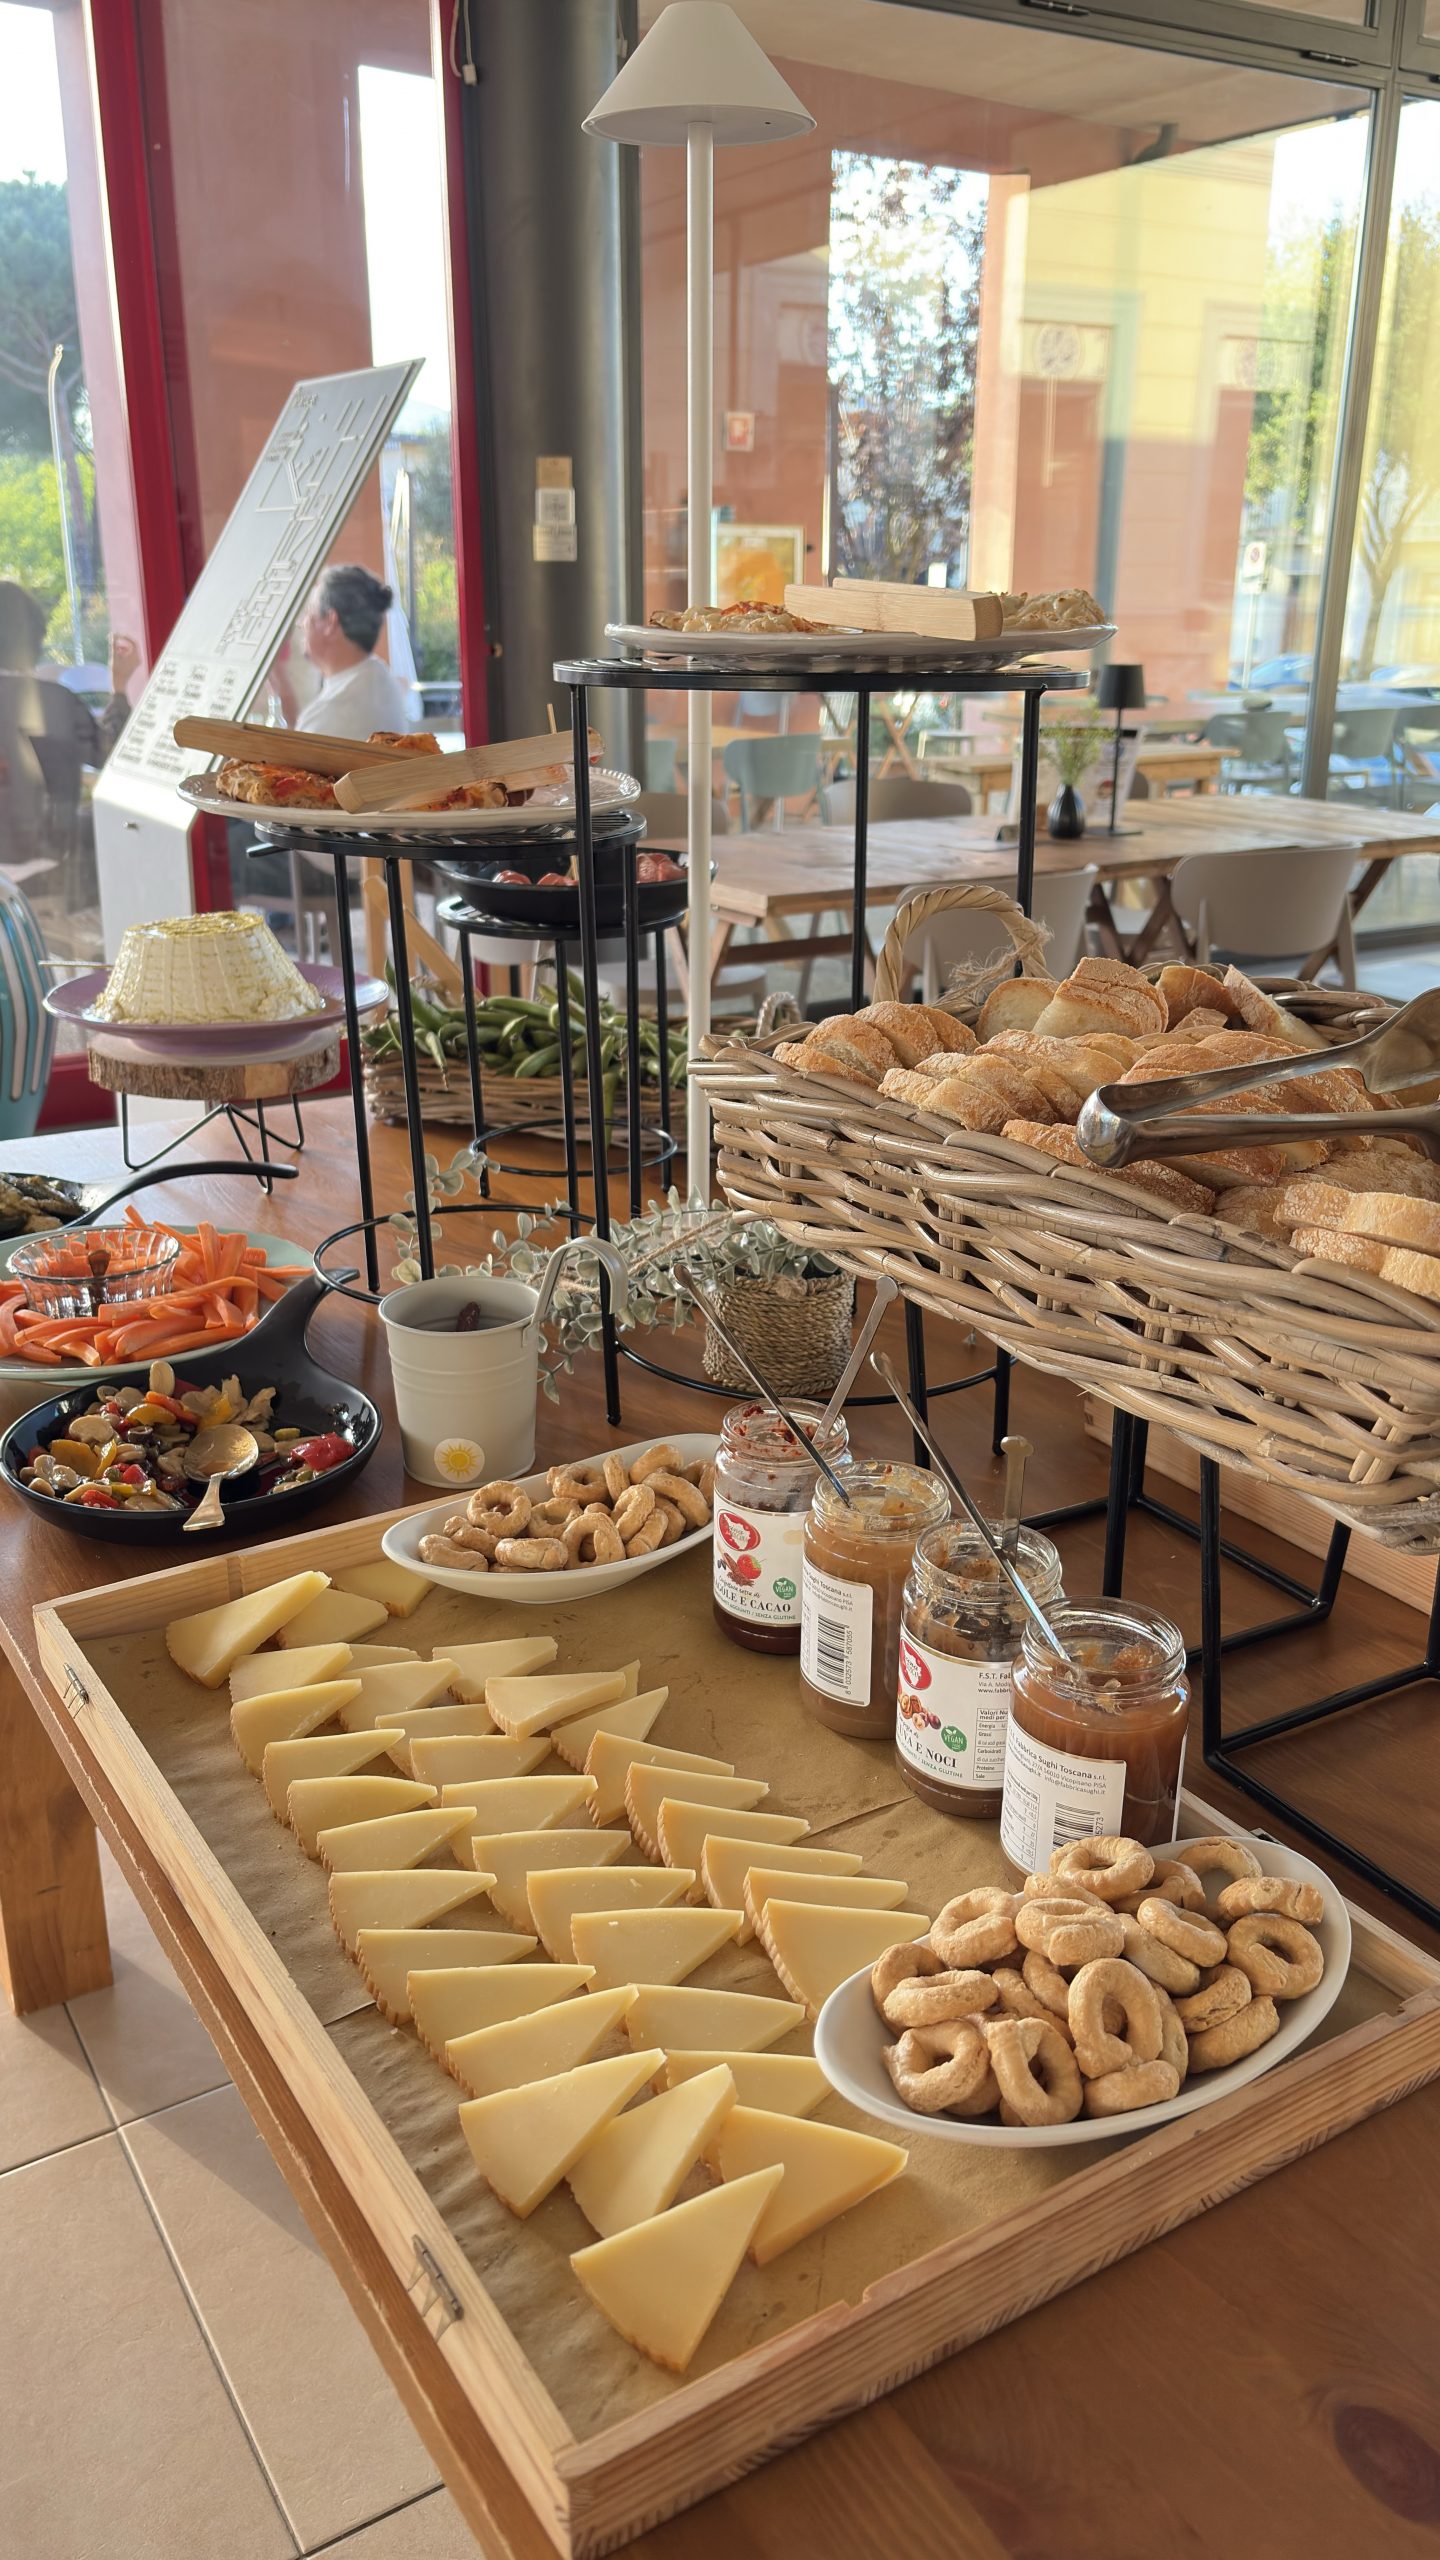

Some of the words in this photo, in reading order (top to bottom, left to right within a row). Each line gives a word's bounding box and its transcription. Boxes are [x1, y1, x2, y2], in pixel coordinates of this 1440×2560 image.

[775, 1585, 794, 1593] VEGAN
[820, 1581, 842, 1596] Toscana
[740, 1597, 747, 1606] E
[750, 1600, 791, 1613] CACAO
[943, 1733, 964, 1745] VEGAN
[916, 1742, 923, 1755] E
[926, 1746, 958, 1769] NOCI
[1015, 1737, 1037, 1760] Fabbrica
[1038, 1755, 1058, 1769] Sughi
[1059, 1764, 1092, 1779] Toscana
[1095, 1817, 1104, 1836] 5273
